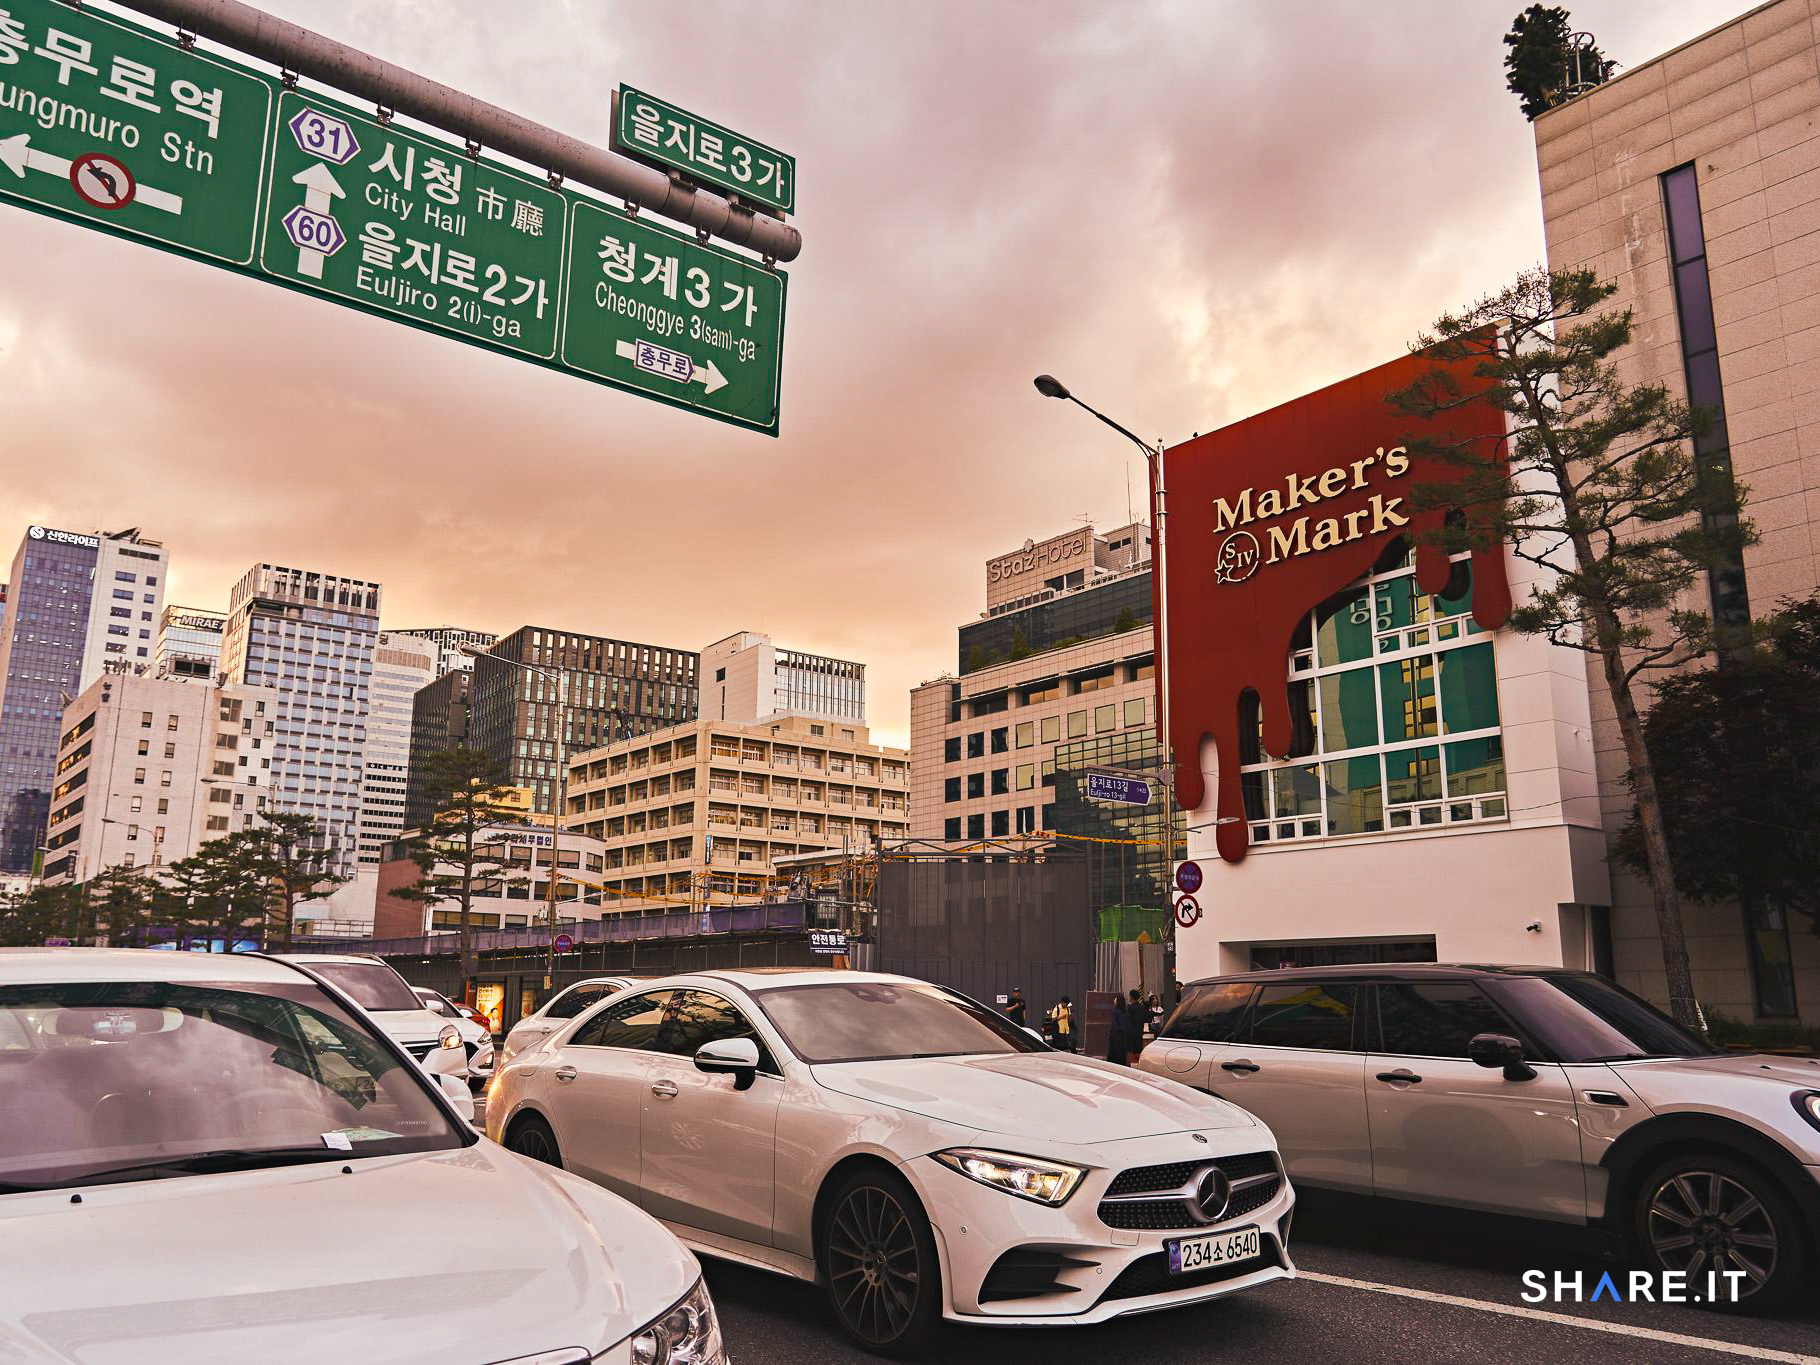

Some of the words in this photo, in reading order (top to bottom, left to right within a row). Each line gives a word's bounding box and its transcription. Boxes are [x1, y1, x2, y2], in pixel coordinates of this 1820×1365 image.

[160, 131, 214, 175] Stn
[306, 117, 342, 155] 31
[630, 103, 785, 199] 을지로3가
[367, 141, 463, 206] 시청
[298, 214, 332, 248] 60
[364, 182, 414, 221] City
[424, 202, 467, 237] Hall
[475, 186, 544, 237] 市廳
[358, 221, 549, 320] 을지로2가
[356, 265, 438, 312] Euljiro
[447, 295, 521, 338] 2(i)-ga
[595, 281, 684, 337] Cheonggye
[689, 314, 756, 362] 3(sam)-ga
[640, 346, 688, 376] 충무로
[1212, 446, 1410, 533] Maker's
[46, 529, 99, 548] 신한라이프
[1265, 493, 1410, 565] Mark
[181, 615, 220, 629] MIRAE
[1090, 776, 1129, 793] 을지로13길
[811, 933, 847, 946] 안전통로
[1226, 1231, 1258, 1260] 6540
